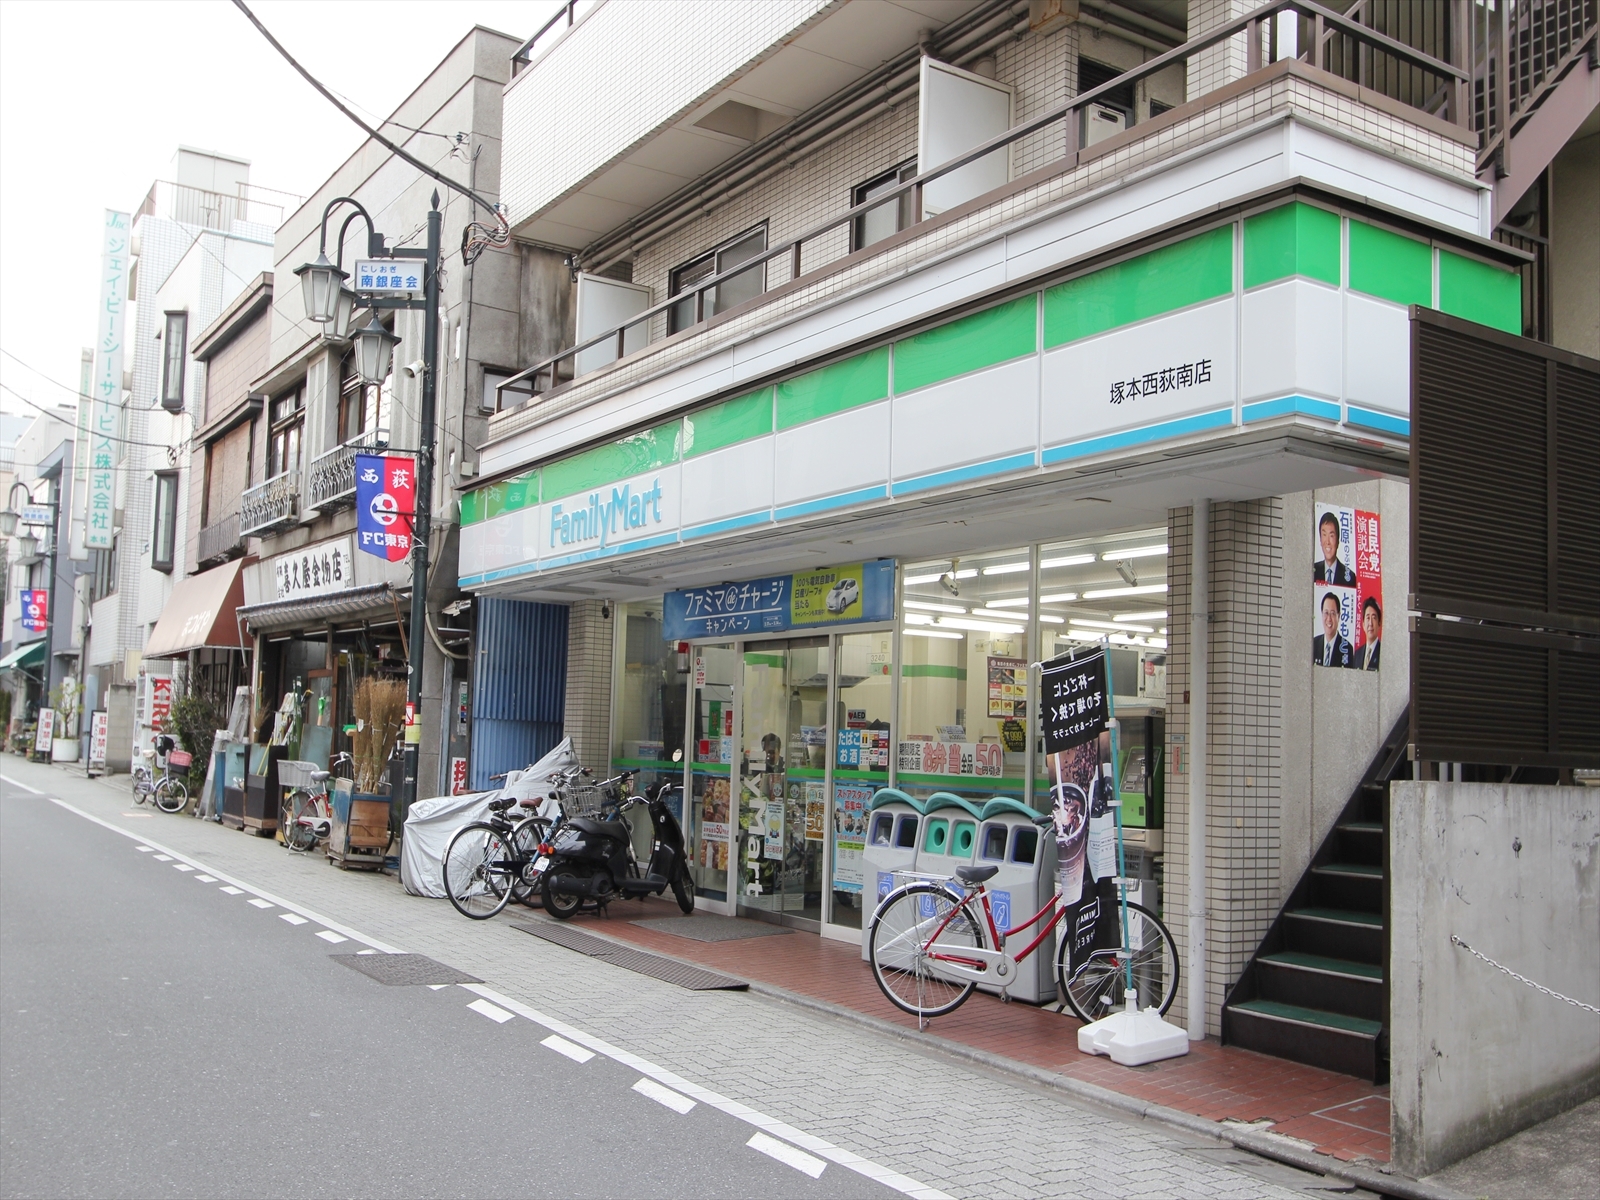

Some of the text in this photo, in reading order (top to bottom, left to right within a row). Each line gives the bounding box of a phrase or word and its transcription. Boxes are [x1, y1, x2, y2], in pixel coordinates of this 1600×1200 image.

[361, 265, 397, 273] にしおぎ
[361, 275, 417, 288] 南銀座会
[1110, 358, 1212, 405] 塚本西荻南店
[360, 468, 410, 489] 西荻
[550, 476, 663, 549] FamilyMart
[362, 531, 409, 549] FC東京
[1357, 516, 1369, 570] 演説会
[1368, 517, 1380, 572] 自民党
[283, 547, 342, 594] 喜久屋金物店
[706, 617, 750, 634] キャンペーン
[151, 678, 172, 742] KIRI
[853, 711, 866, 719] AED
[838, 731, 860, 746] たばこ
[840, 748, 858, 763] お酒
[923, 742, 961, 775] お弁当
[837, 789, 872, 801] ストアスタッフ
